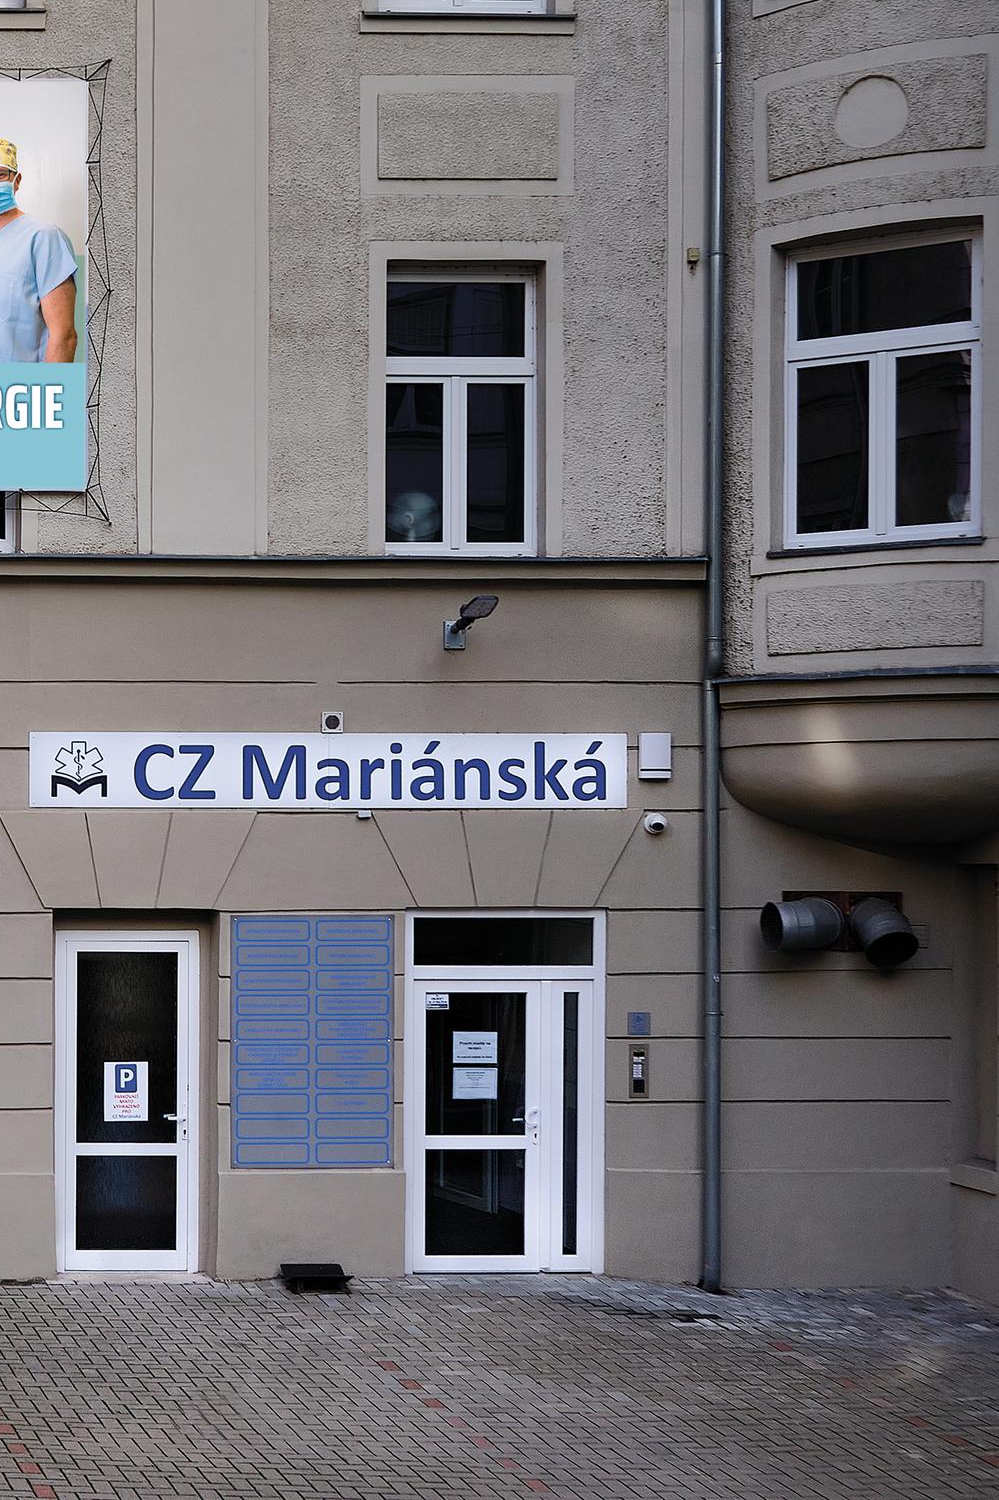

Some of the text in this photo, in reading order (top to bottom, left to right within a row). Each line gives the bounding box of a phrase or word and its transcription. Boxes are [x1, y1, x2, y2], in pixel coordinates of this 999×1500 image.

[133, 740, 607, 801] CZ Mariánská
[120, 1068, 134, 1088] P
